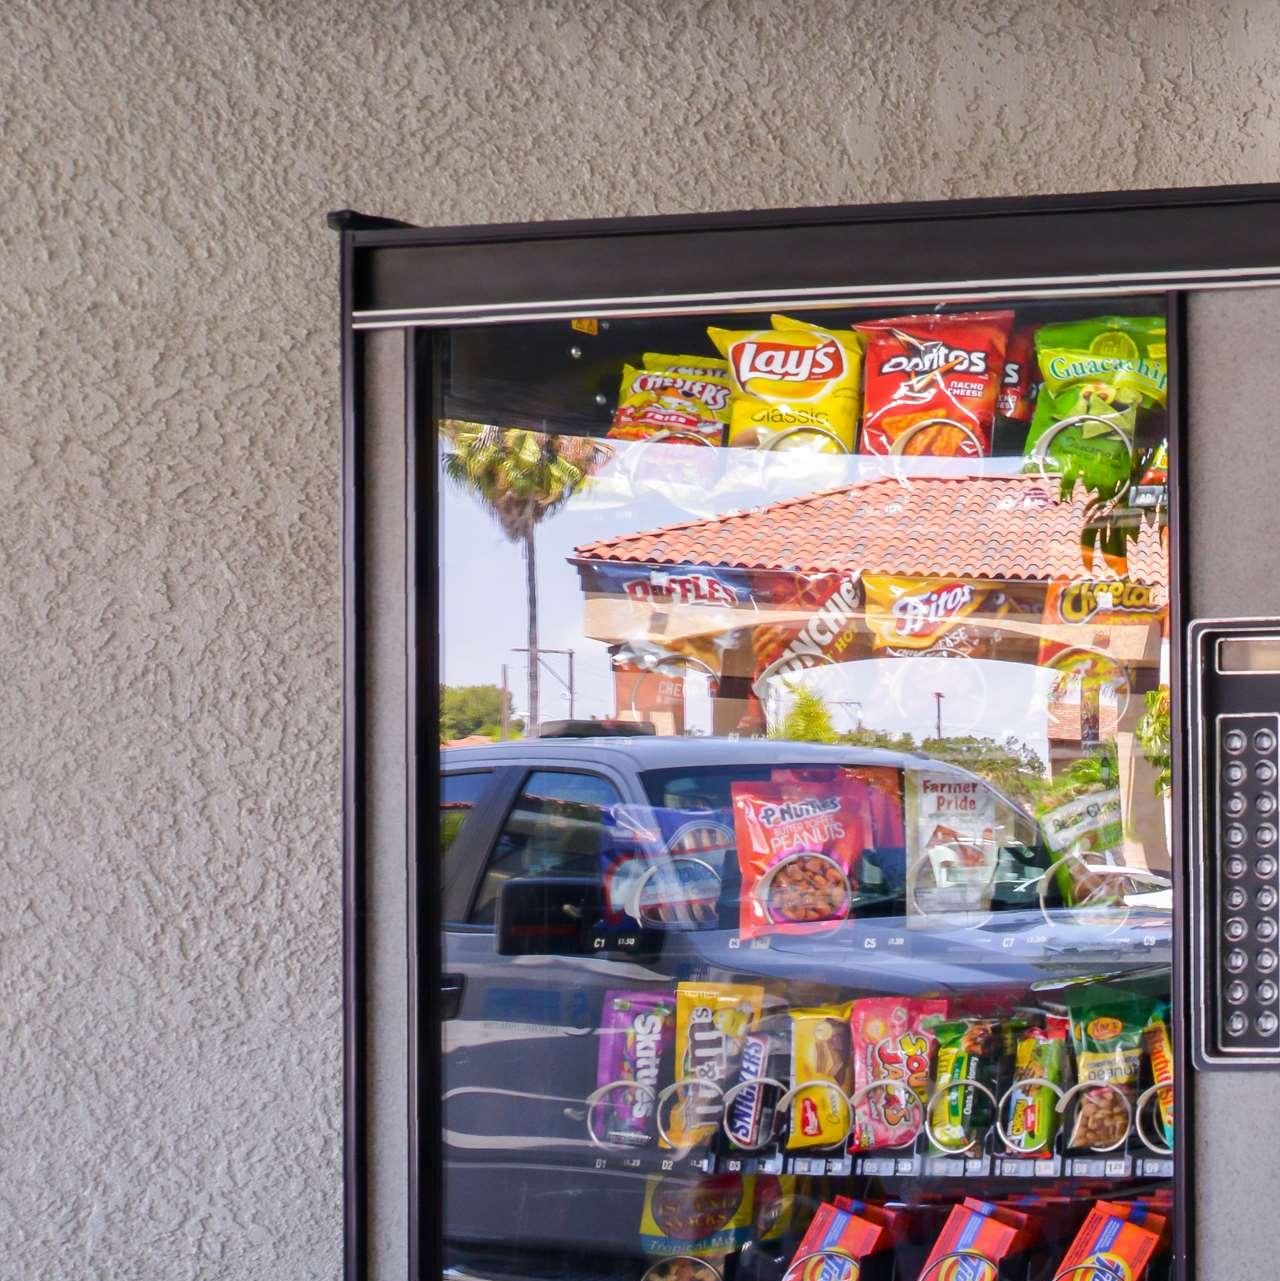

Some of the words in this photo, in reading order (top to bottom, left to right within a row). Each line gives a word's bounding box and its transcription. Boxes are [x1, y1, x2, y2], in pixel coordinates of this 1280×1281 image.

[738, 342, 836, 381] Lay's
[751, 406, 829, 425] Classic
[892, 583, 977, 636] Fritos
[936, 795, 976, 811] Pride
[770, 821, 846, 851] PEANUTS
[662, 1160, 673, 1170] D2
